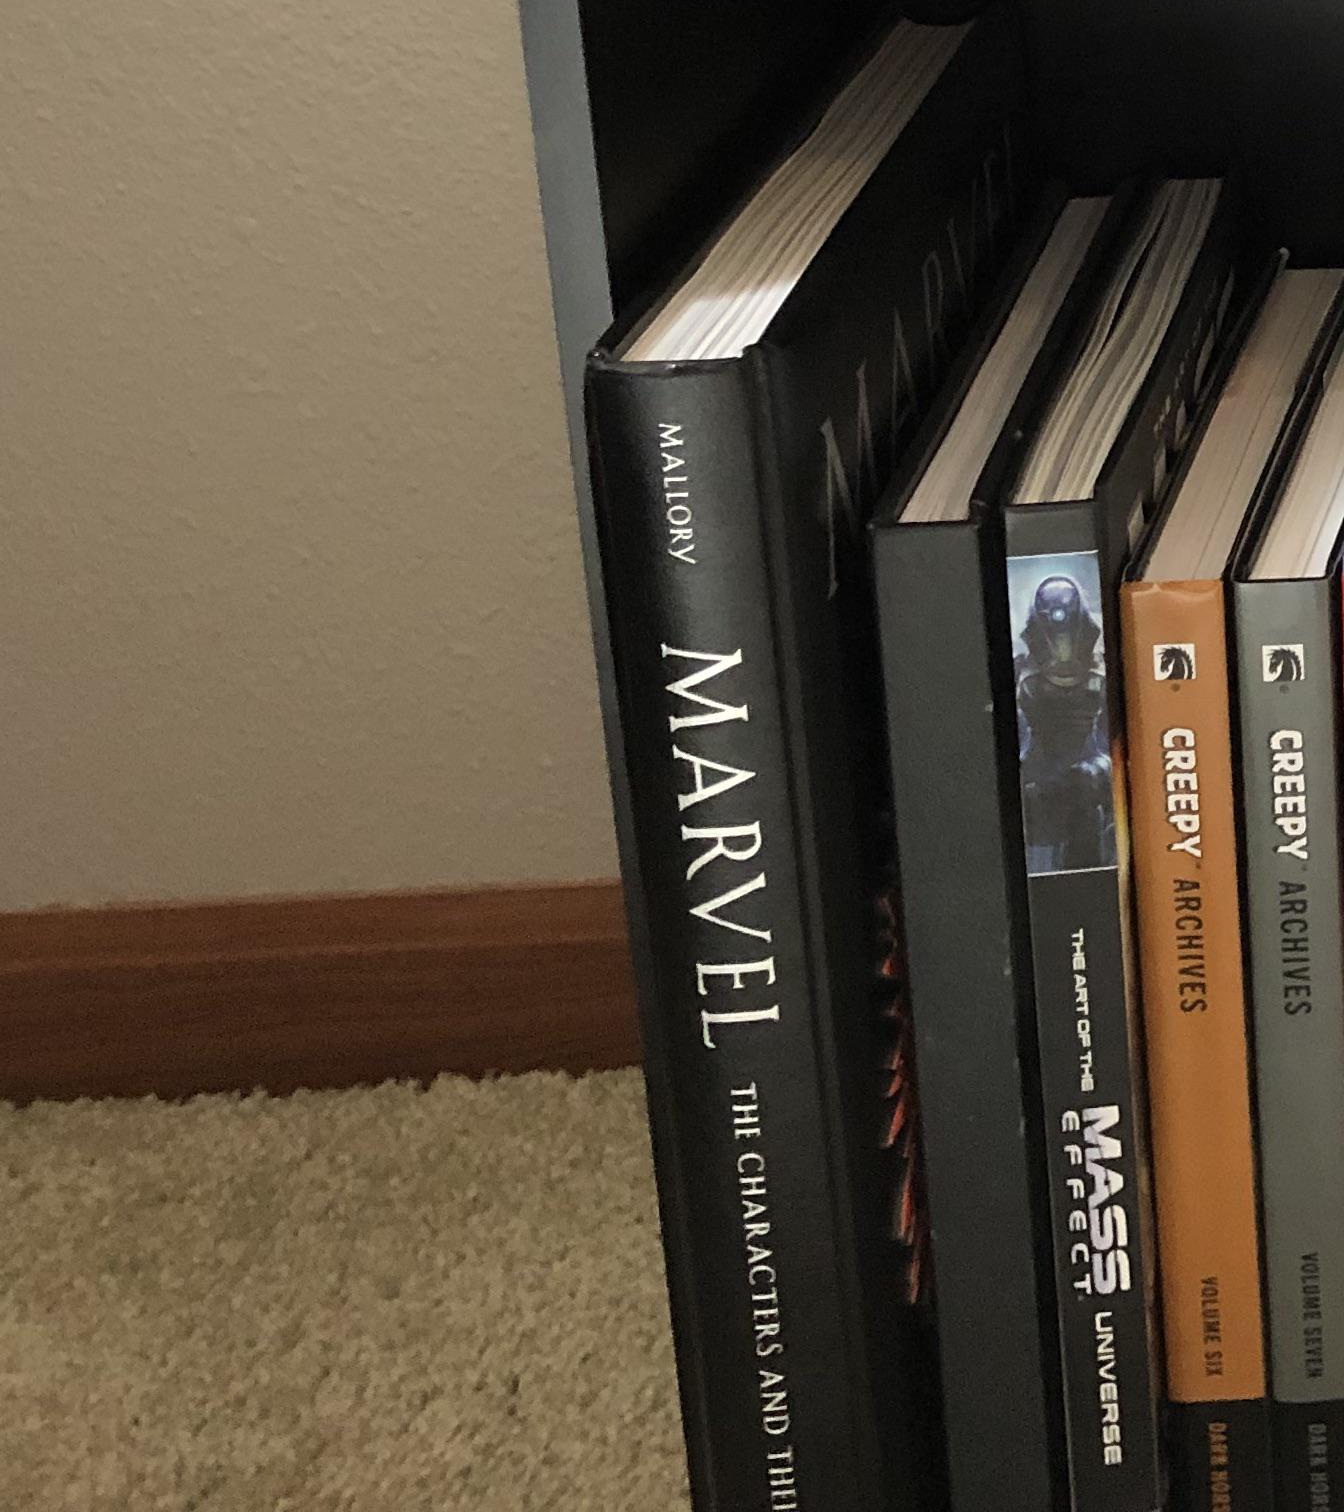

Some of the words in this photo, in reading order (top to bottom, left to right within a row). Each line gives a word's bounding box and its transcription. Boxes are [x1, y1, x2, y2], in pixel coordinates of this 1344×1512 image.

[657, 422, 696, 565] MALLORY
[1161, 726, 1202, 858] CREEPY
[1270, 728, 1308, 861] CREEPY
[660, 643, 781, 1049] MARVEL
[1070, 928, 1086, 974] THE
[1172, 878, 1208, 1014] ARCHIVES
[1278, 880, 1312, 1016] ARCHIVES
[1072, 975, 1089, 1019] ART
[1077, 1020, 1092, 1048] OF
[730, 1081, 761, 1141] THE
[1079, 1049, 1094, 1092] THE
[1061, 1110, 1093, 1297] EFFECT
[1082, 1104, 1132, 1295] MASS
[736, 1151, 783, 1359] CHARACTERS
[1300, 1252, 1322, 1323] VOLUME
[1200, 1275, 1223, 1346] VOLUME
[1304, 1327, 1322, 1379] SEVEN
[758, 1368, 791, 1436] AND
[1094, 1311, 1122, 1467] UNIVERSE
[1204, 1349, 1222, 1378] SIX
